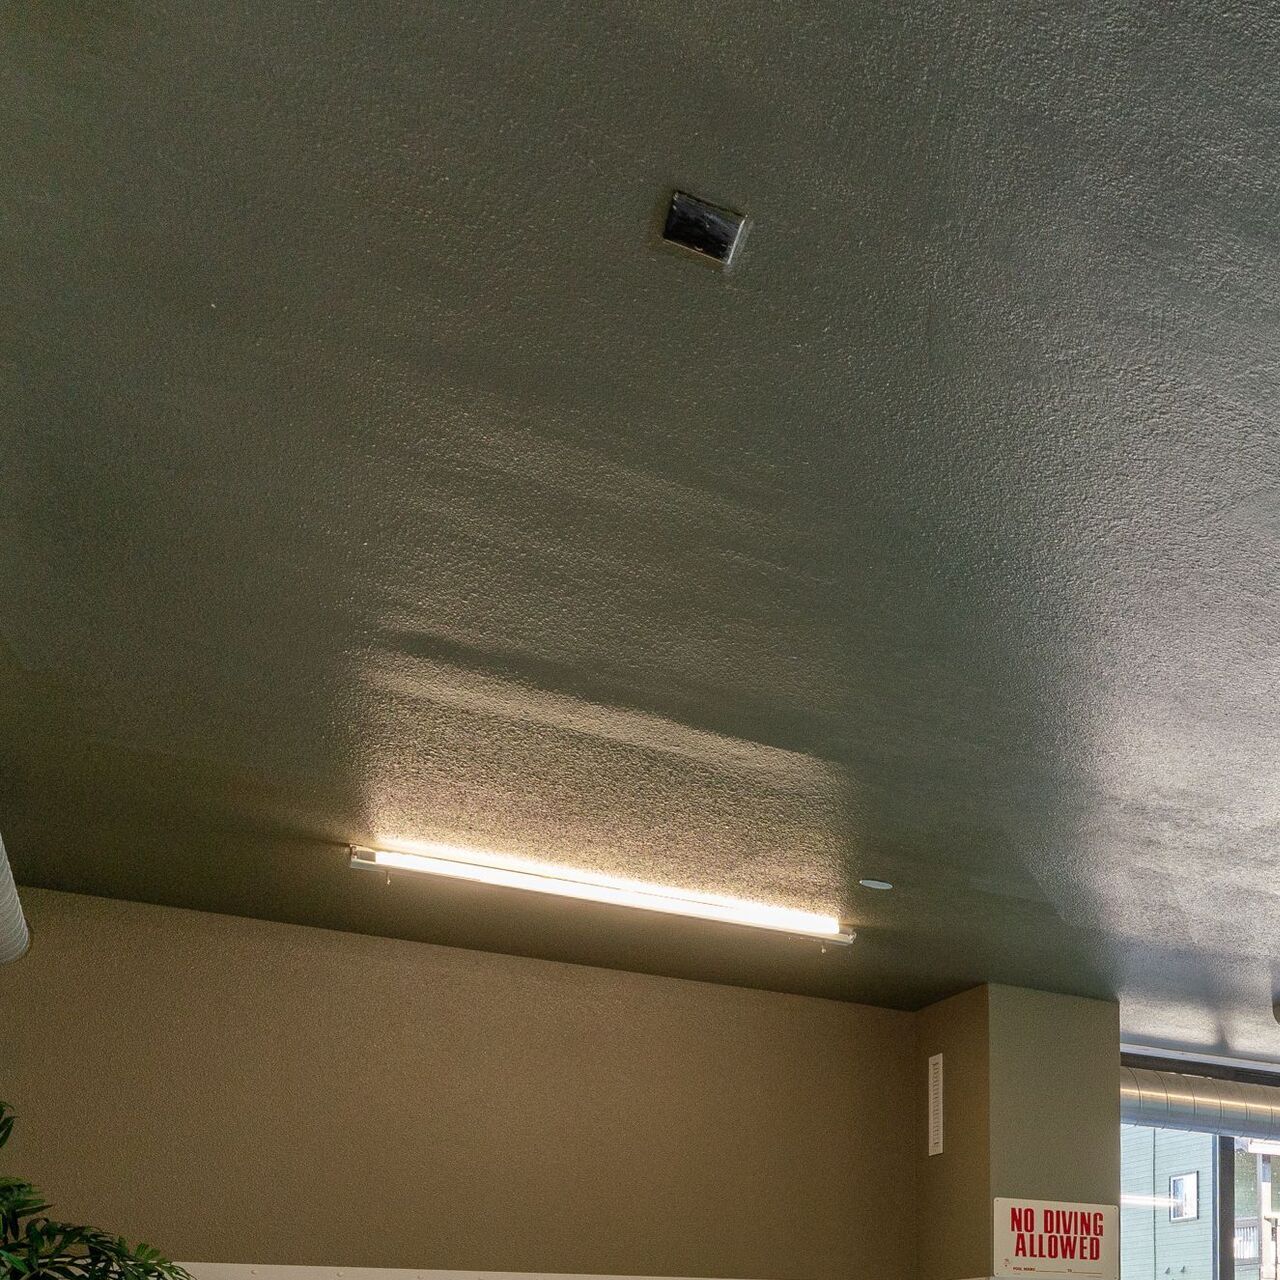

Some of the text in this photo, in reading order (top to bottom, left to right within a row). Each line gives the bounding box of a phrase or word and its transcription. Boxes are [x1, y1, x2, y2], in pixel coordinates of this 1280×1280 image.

[1010, 1208, 1104, 1237] NO DIVING
[1015, 1233, 1100, 1260] ALLOWED
